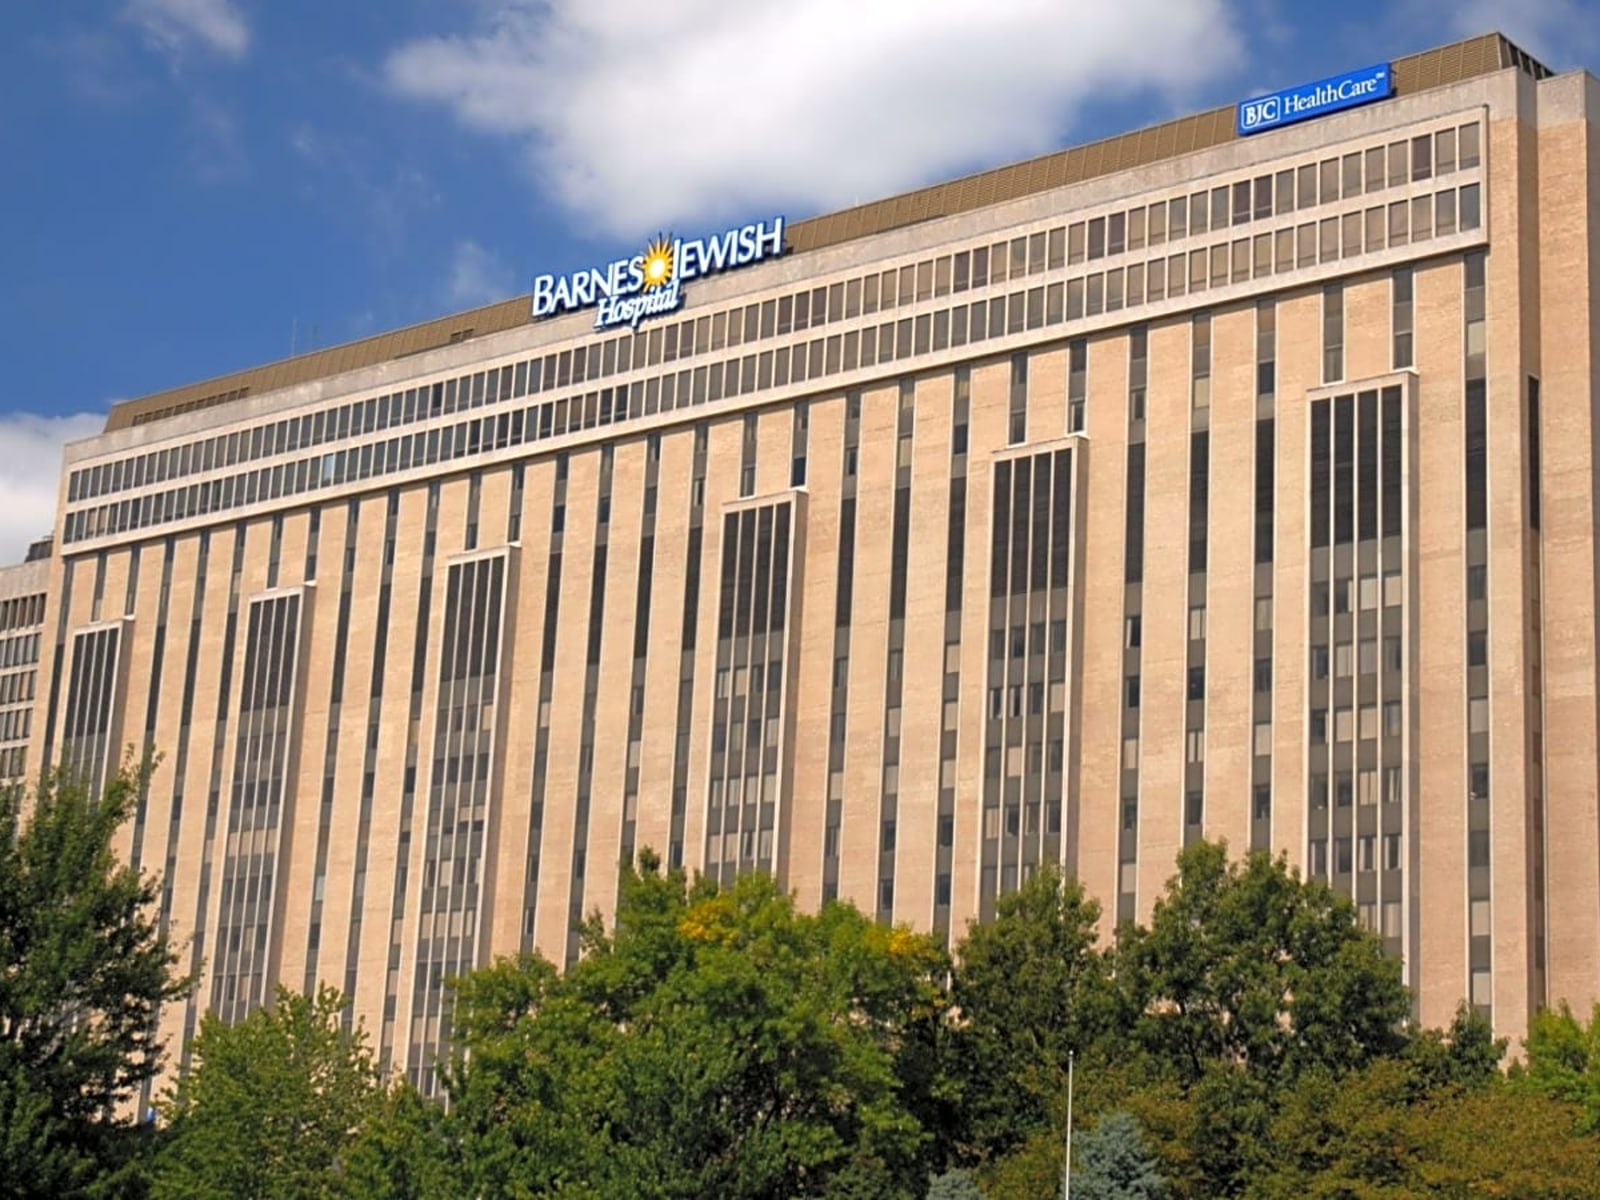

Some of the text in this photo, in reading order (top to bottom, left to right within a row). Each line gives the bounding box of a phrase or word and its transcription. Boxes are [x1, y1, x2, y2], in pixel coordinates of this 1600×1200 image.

[1246, 79, 1376, 126] BJC HealthCare
[532, 217, 783, 317] BARNES JEWISH
[594, 279, 679, 327] Hospital
